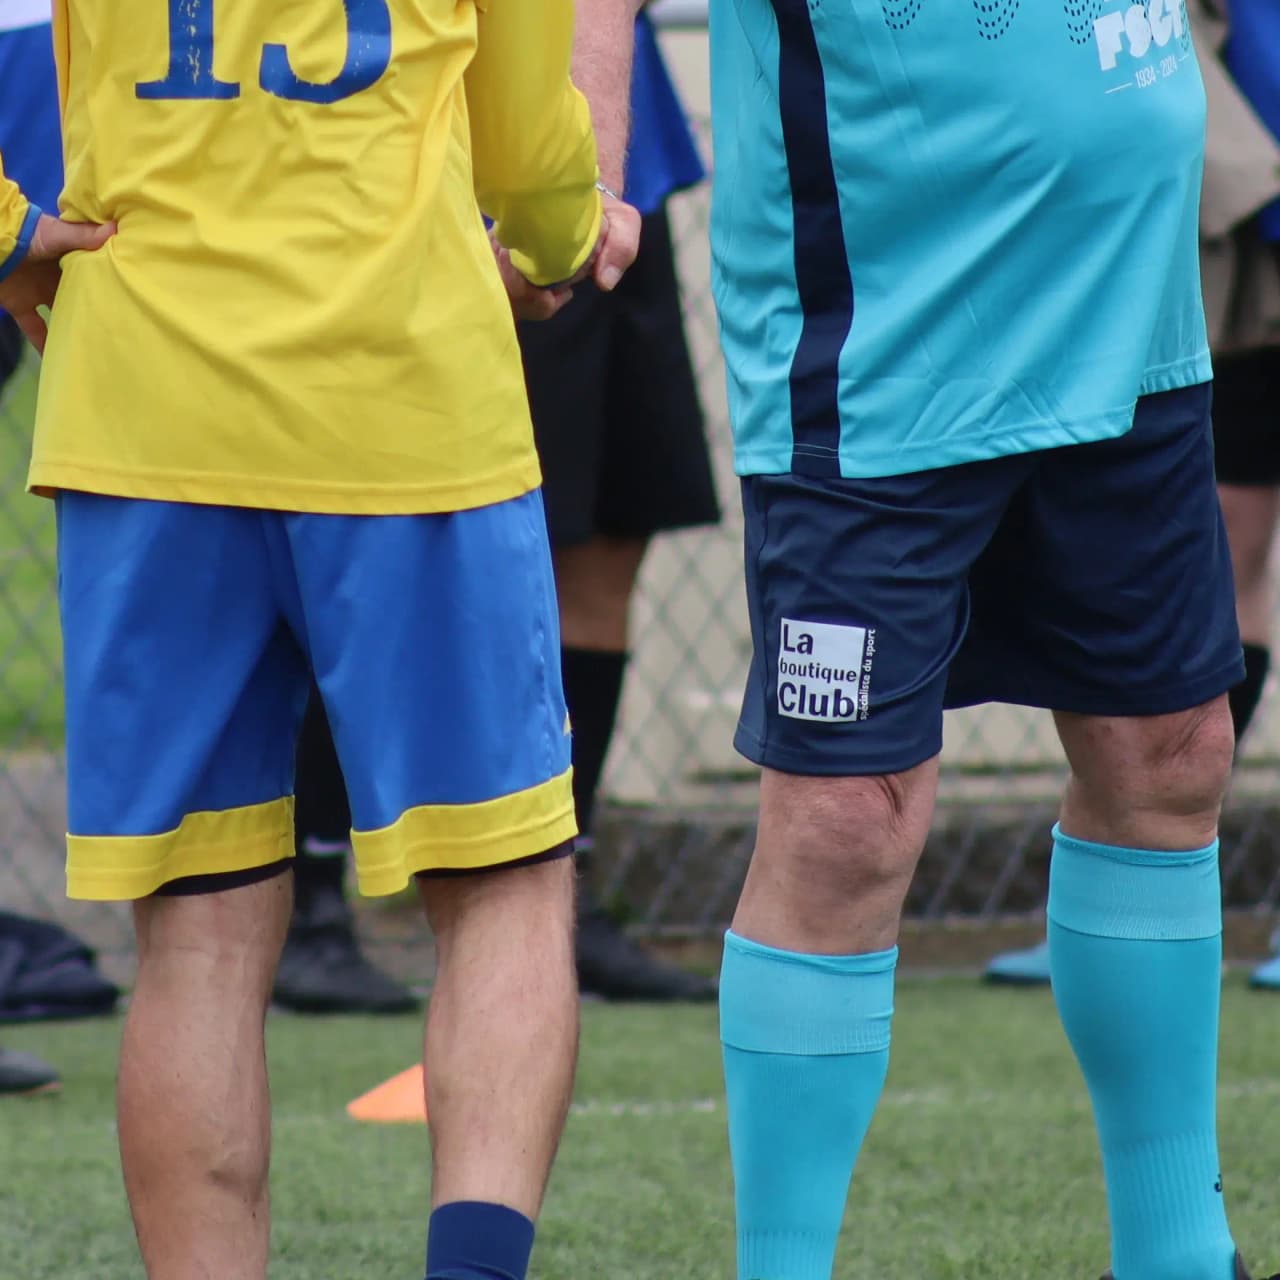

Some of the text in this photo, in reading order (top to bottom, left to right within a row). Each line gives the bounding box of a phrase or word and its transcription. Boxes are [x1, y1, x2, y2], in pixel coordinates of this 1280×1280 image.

[783, 623, 814, 655] La
[865, 628, 876, 657] sport
[780, 658, 857, 684] boutique
[862, 659, 873, 672] du
[779, 682, 855, 718] Club
